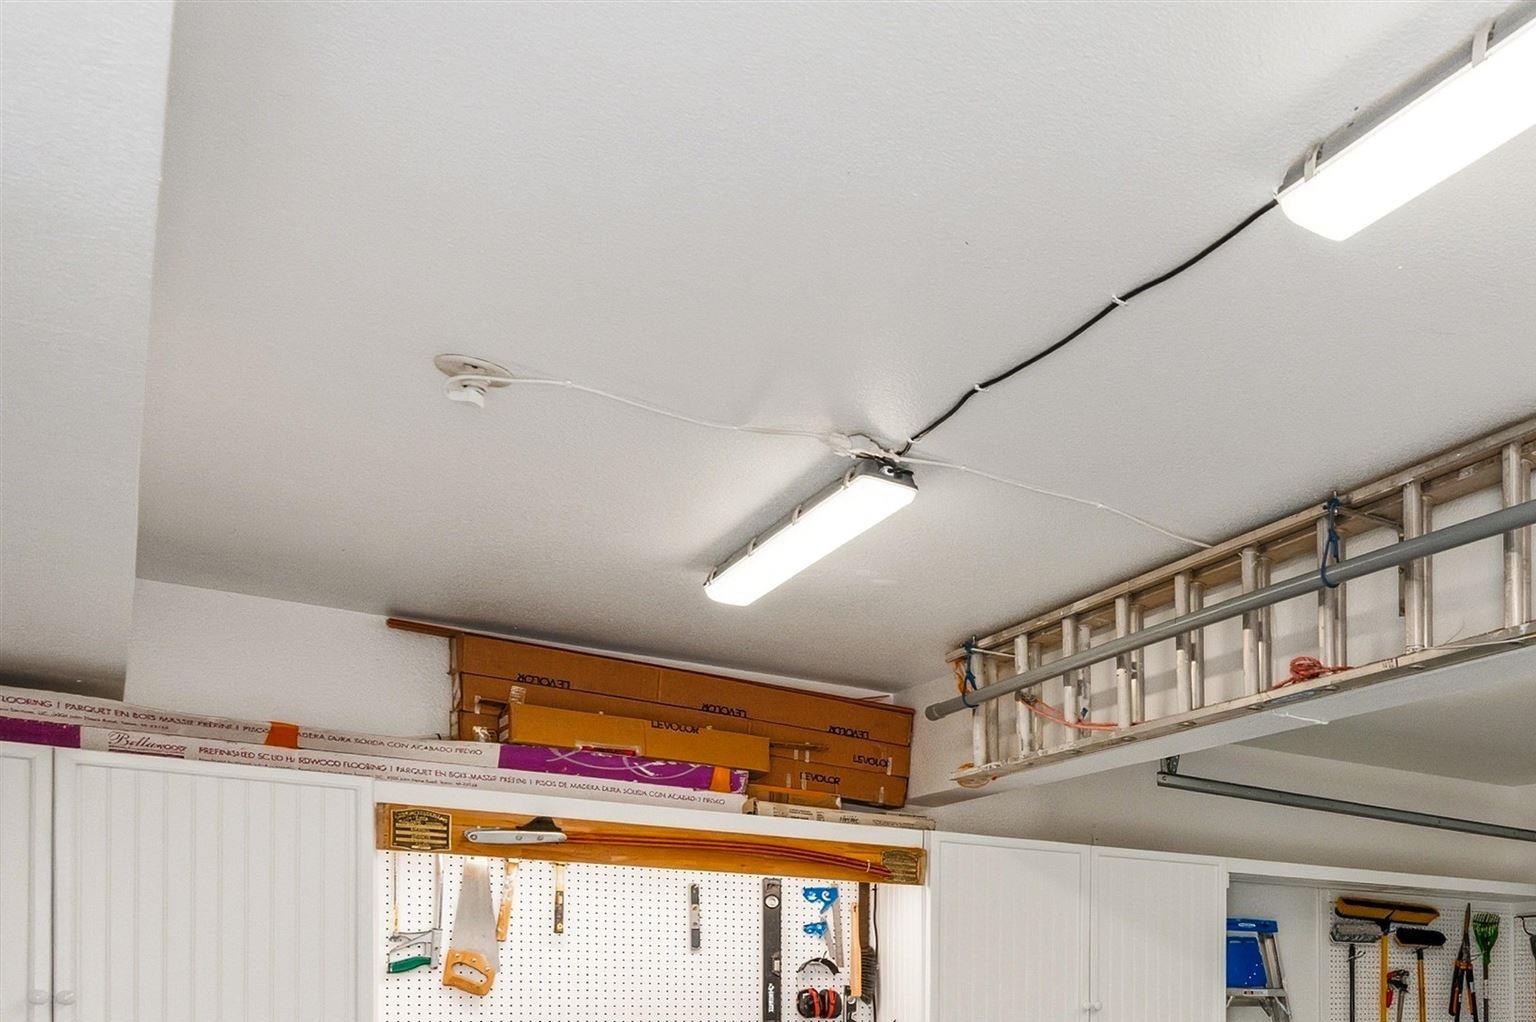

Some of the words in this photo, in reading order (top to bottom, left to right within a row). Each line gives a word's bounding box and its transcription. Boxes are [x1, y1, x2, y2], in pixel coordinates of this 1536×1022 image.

[516, 672, 571, 689] LEVOLOR
[701, 703, 747, 718] LEVOLOR
[64, 702, 111, 715] PARQUET
[114, 709, 129, 718] EN
[386, 741, 409, 749] CON
[651, 720, 699, 734] LEVOLOR
[343, 761, 387, 772] FLOORING
[396, 766, 432, 776] PARQUET
[434, 769, 447, 778] EN
